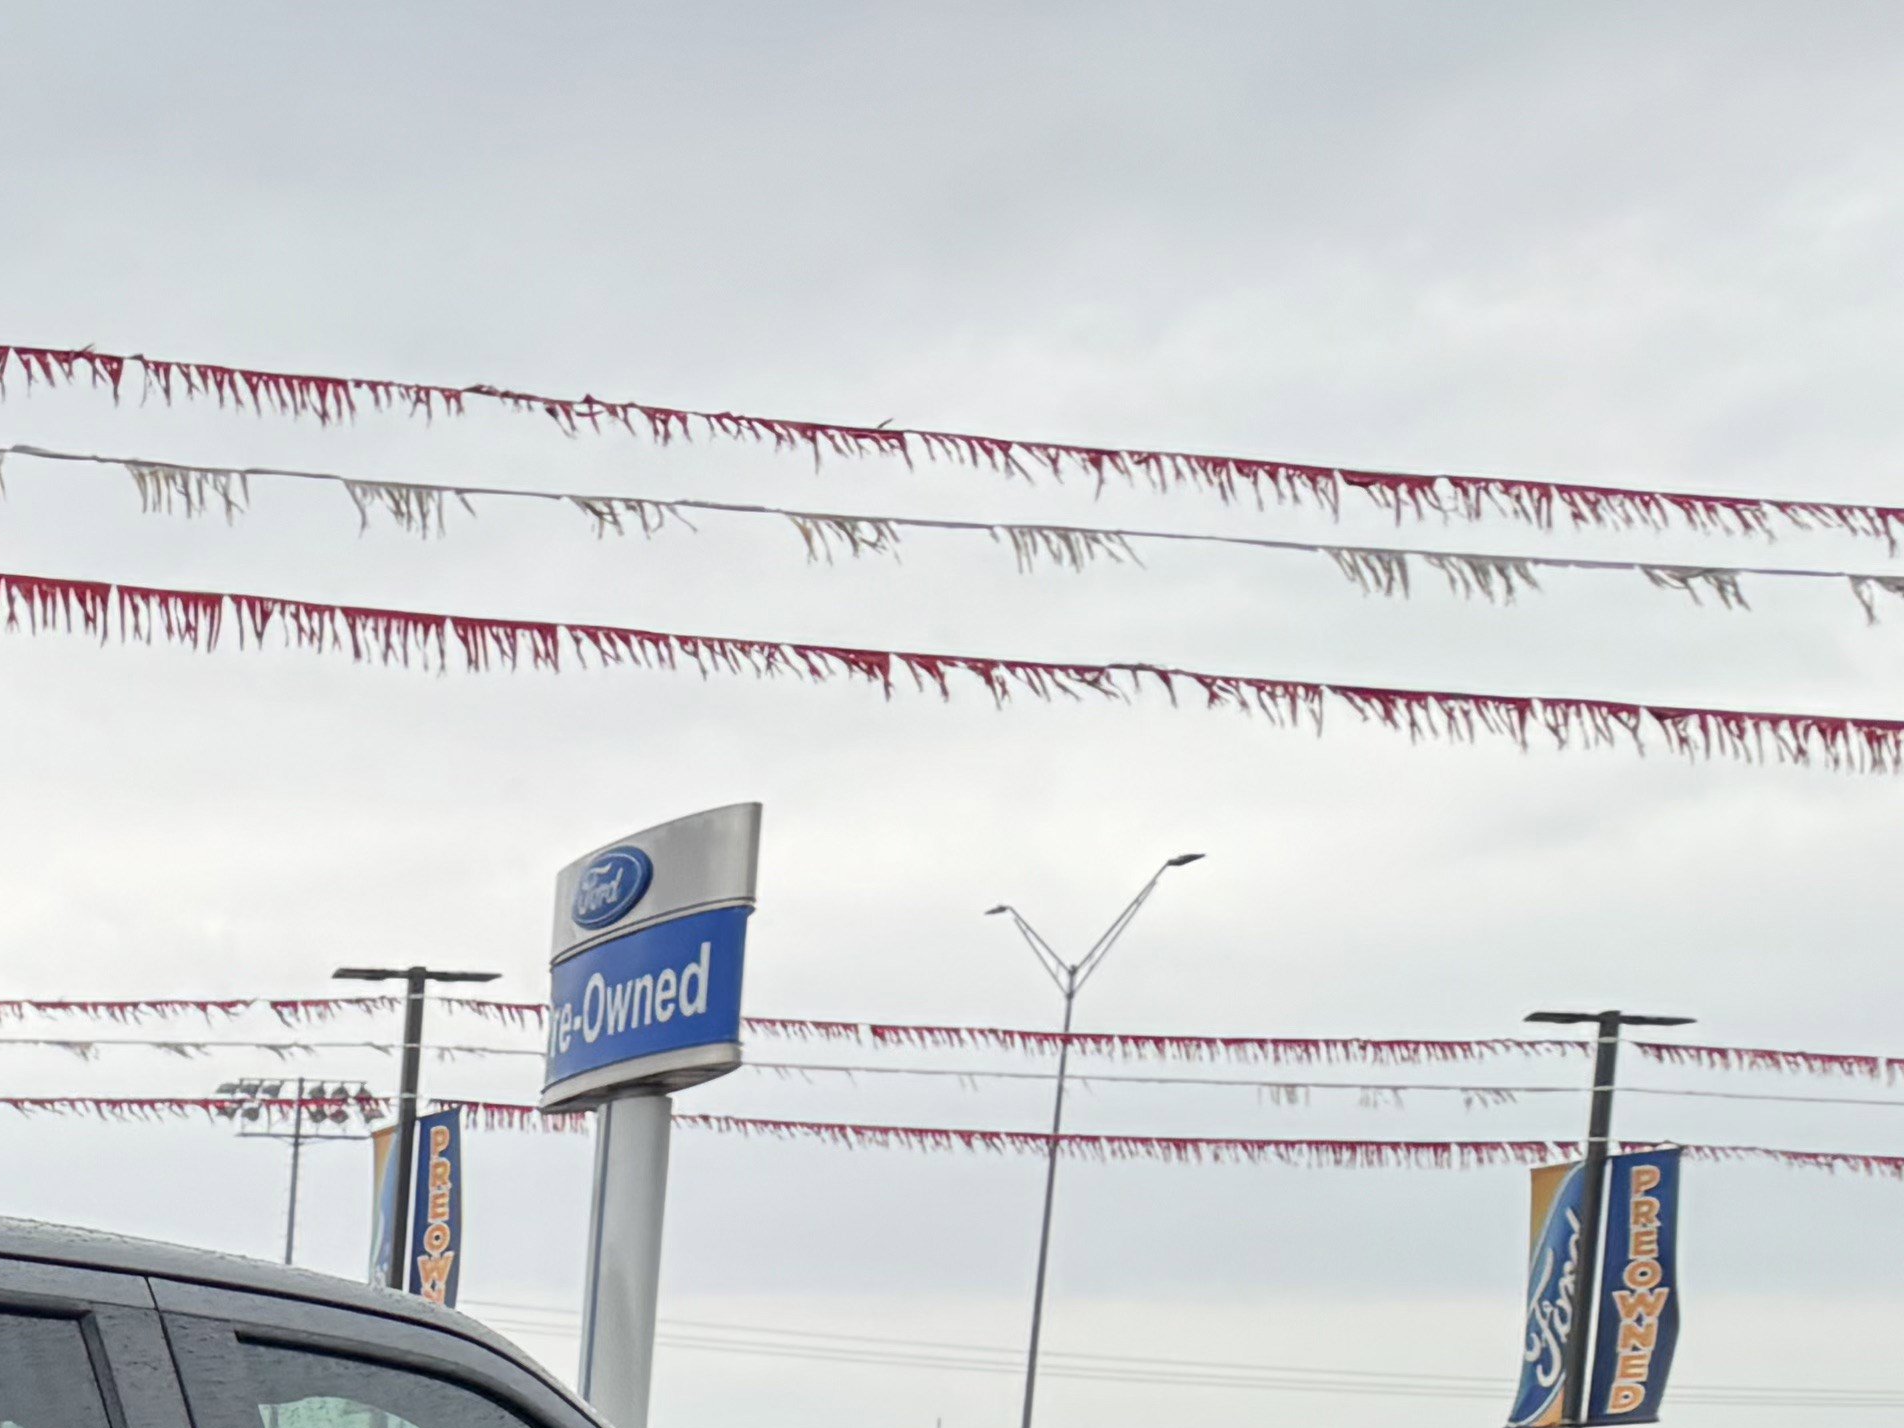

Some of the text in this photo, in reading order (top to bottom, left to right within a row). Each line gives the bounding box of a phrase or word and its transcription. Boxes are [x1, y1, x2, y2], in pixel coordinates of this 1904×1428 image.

[576, 862, 623, 915] Ford
[549, 942, 711, 1058] re-Owned
[417, 1125, 455, 1305] PREOW
[1607, 1165, 1670, 1414] PREOWNED
